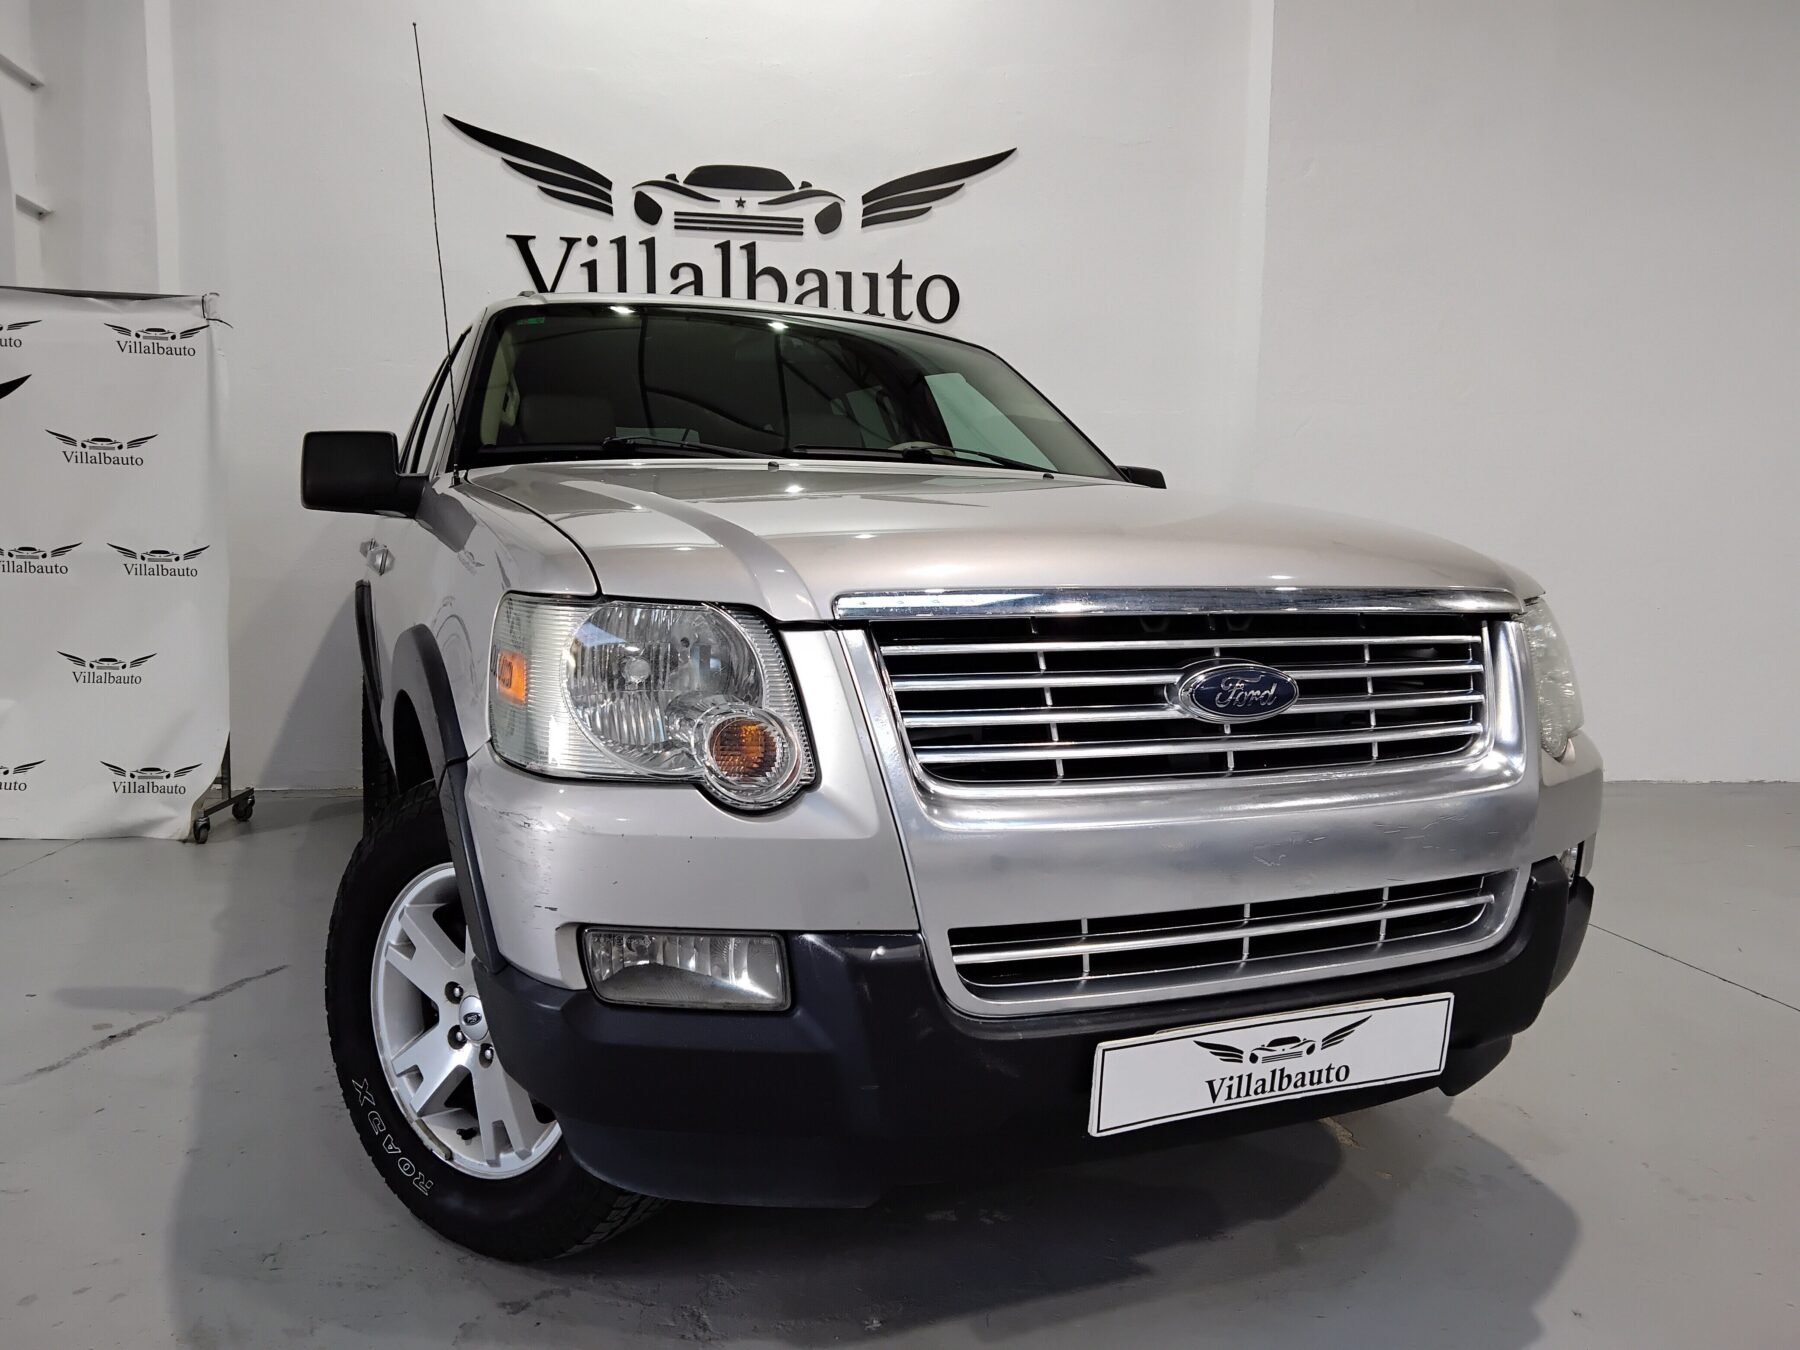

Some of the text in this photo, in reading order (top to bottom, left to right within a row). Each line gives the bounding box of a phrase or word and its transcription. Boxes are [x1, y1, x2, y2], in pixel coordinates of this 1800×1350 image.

[506, 234, 960, 324] Villalbauto
[116, 340, 196, 357] Villalbauto
[62, 451, 144, 466] Villalbauto
[0, 561, 68, 575] illalbauto
[123, 563, 198, 577] Villalbauto
[72, 671, 142, 685] Villalbauto
[1215, 674, 1278, 708] Ford
[112, 781, 187, 795] Villalbauto
[1205, 1062, 1351, 1105] Villalbauto
